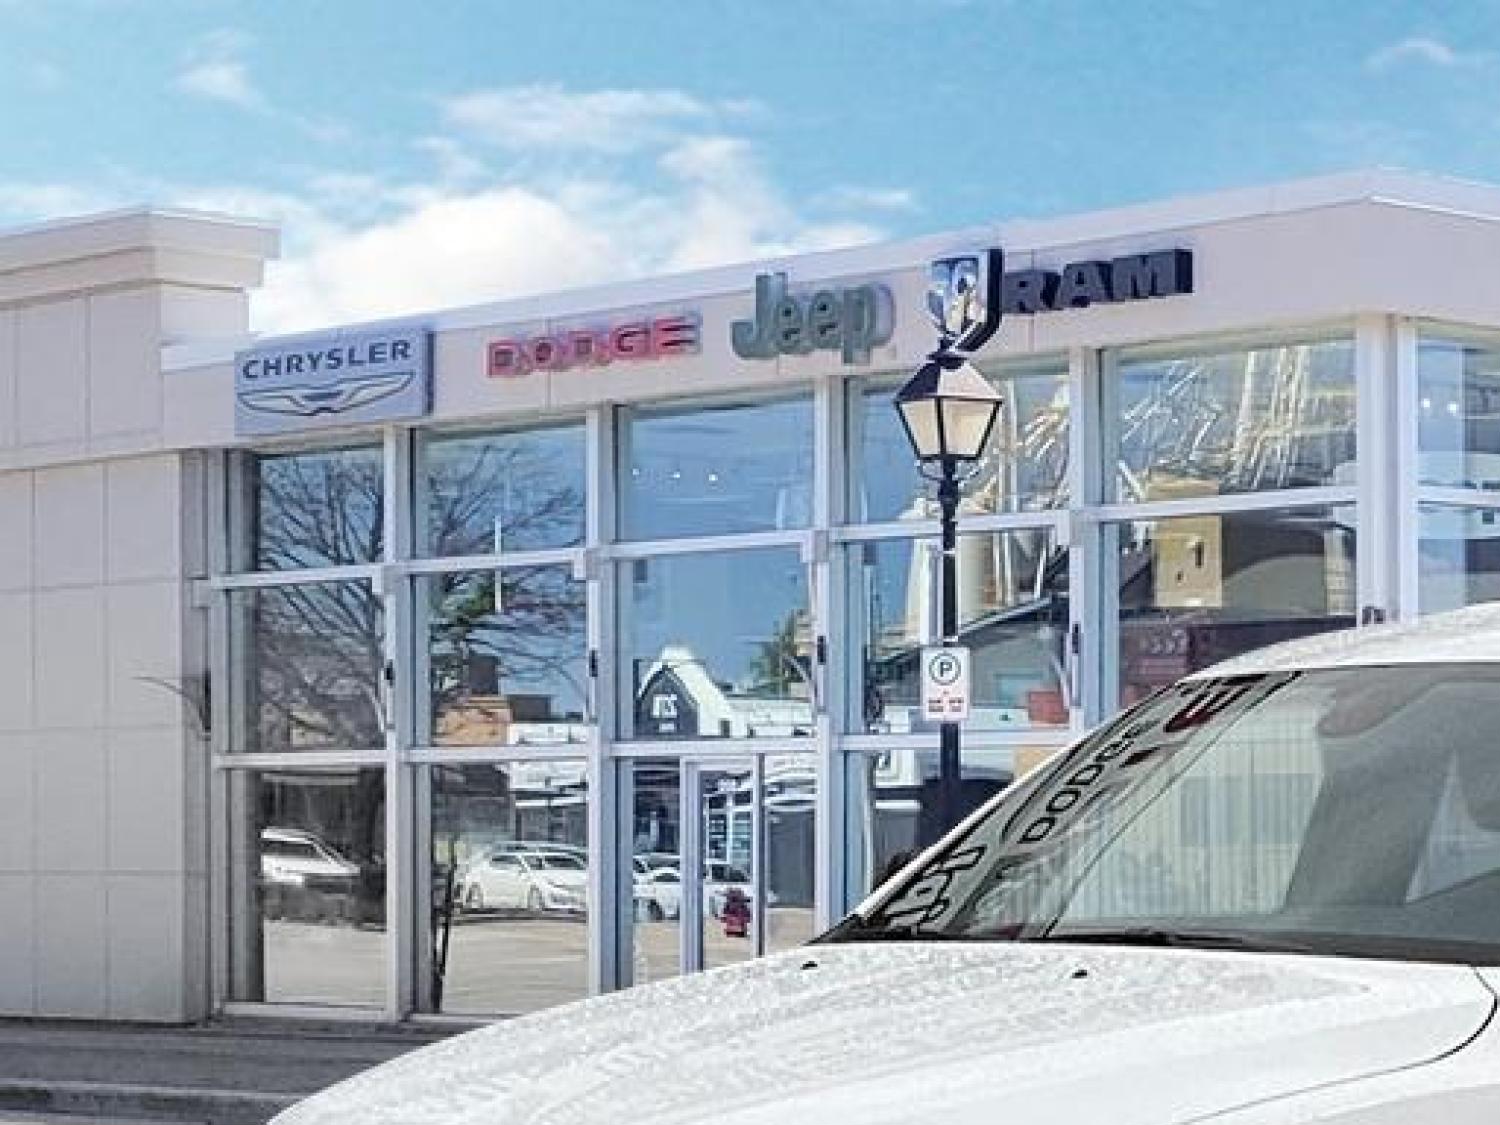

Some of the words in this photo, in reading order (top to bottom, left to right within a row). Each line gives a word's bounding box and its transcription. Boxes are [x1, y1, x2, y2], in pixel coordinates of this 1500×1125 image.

[1002, 248, 1194, 315] RAM
[487, 316, 702, 378] DODGE
[731, 272, 896, 365] Jeep
[241, 338, 412, 380] CHRYSLER
